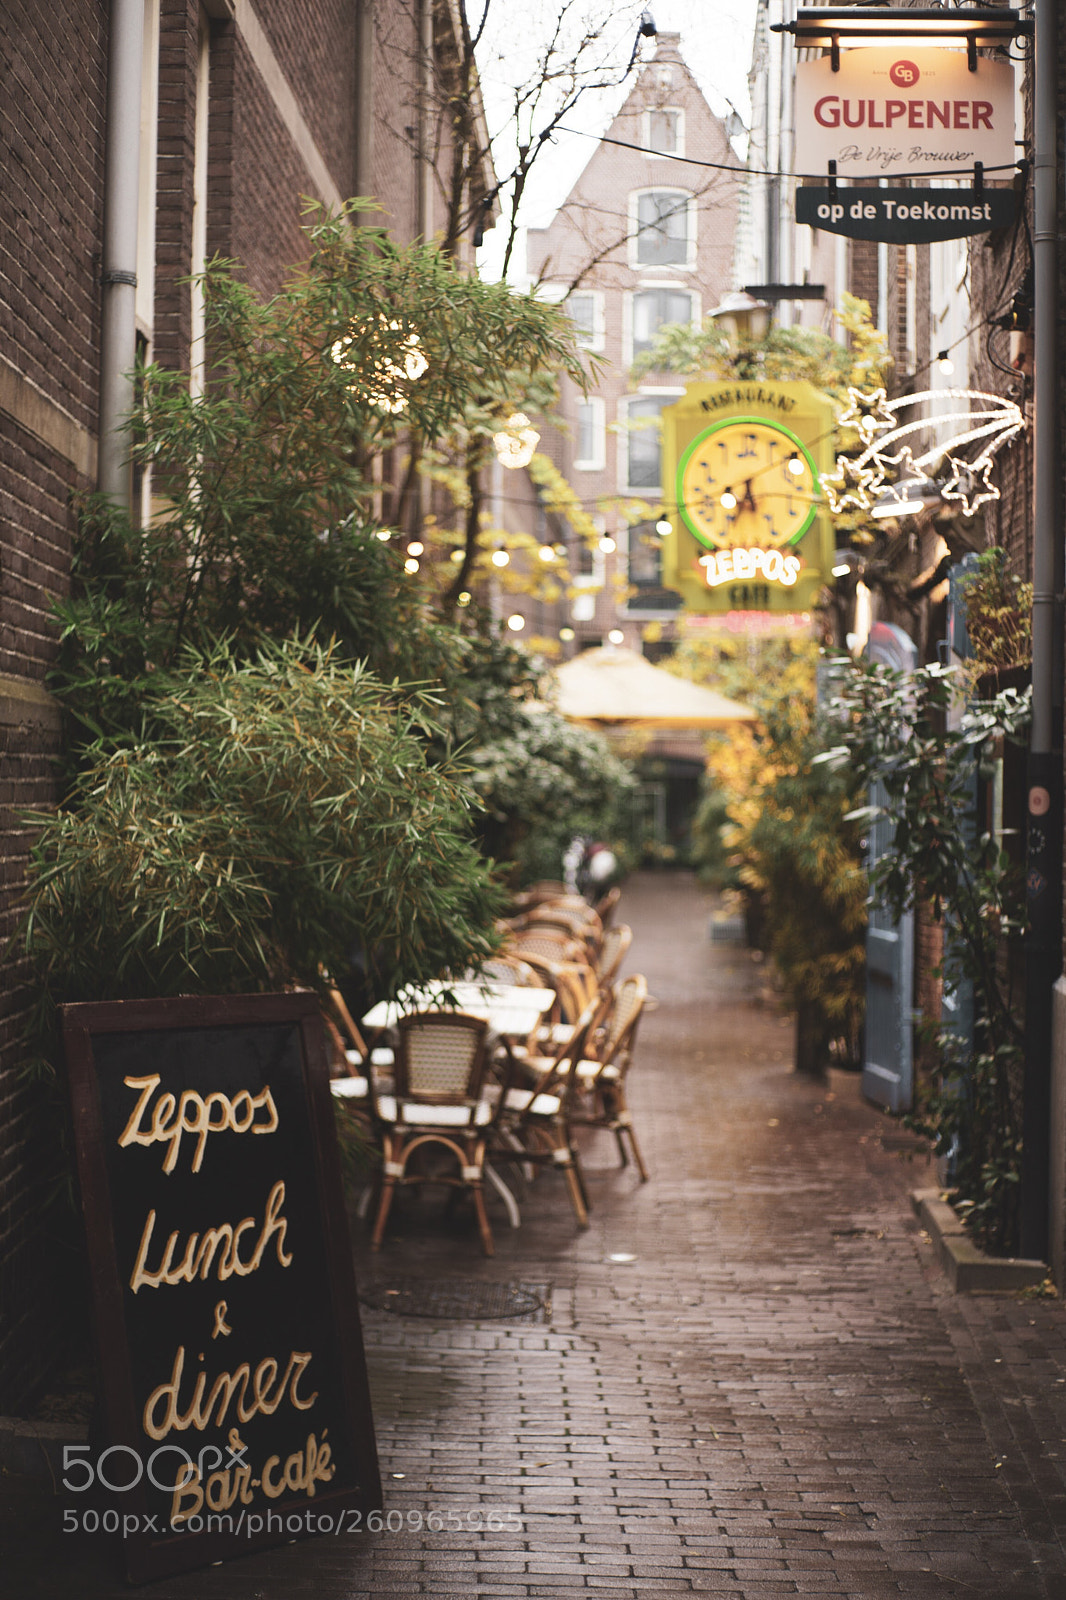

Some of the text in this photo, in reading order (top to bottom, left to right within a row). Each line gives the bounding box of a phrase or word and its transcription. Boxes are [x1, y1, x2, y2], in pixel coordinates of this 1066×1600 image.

[894, 64, 914, 82] GB
[813, 95, 994, 130] GULPENER
[838, 145, 974, 169] De Vrije Brouwer
[817, 201, 992, 223] op de Toekomst
[698, 547, 801, 587] ZEPPOS
[118, 1073, 279, 1175] Zeppos
[129, 1180, 293, 1294] Lunch
[143, 1345, 319, 1441] diner
